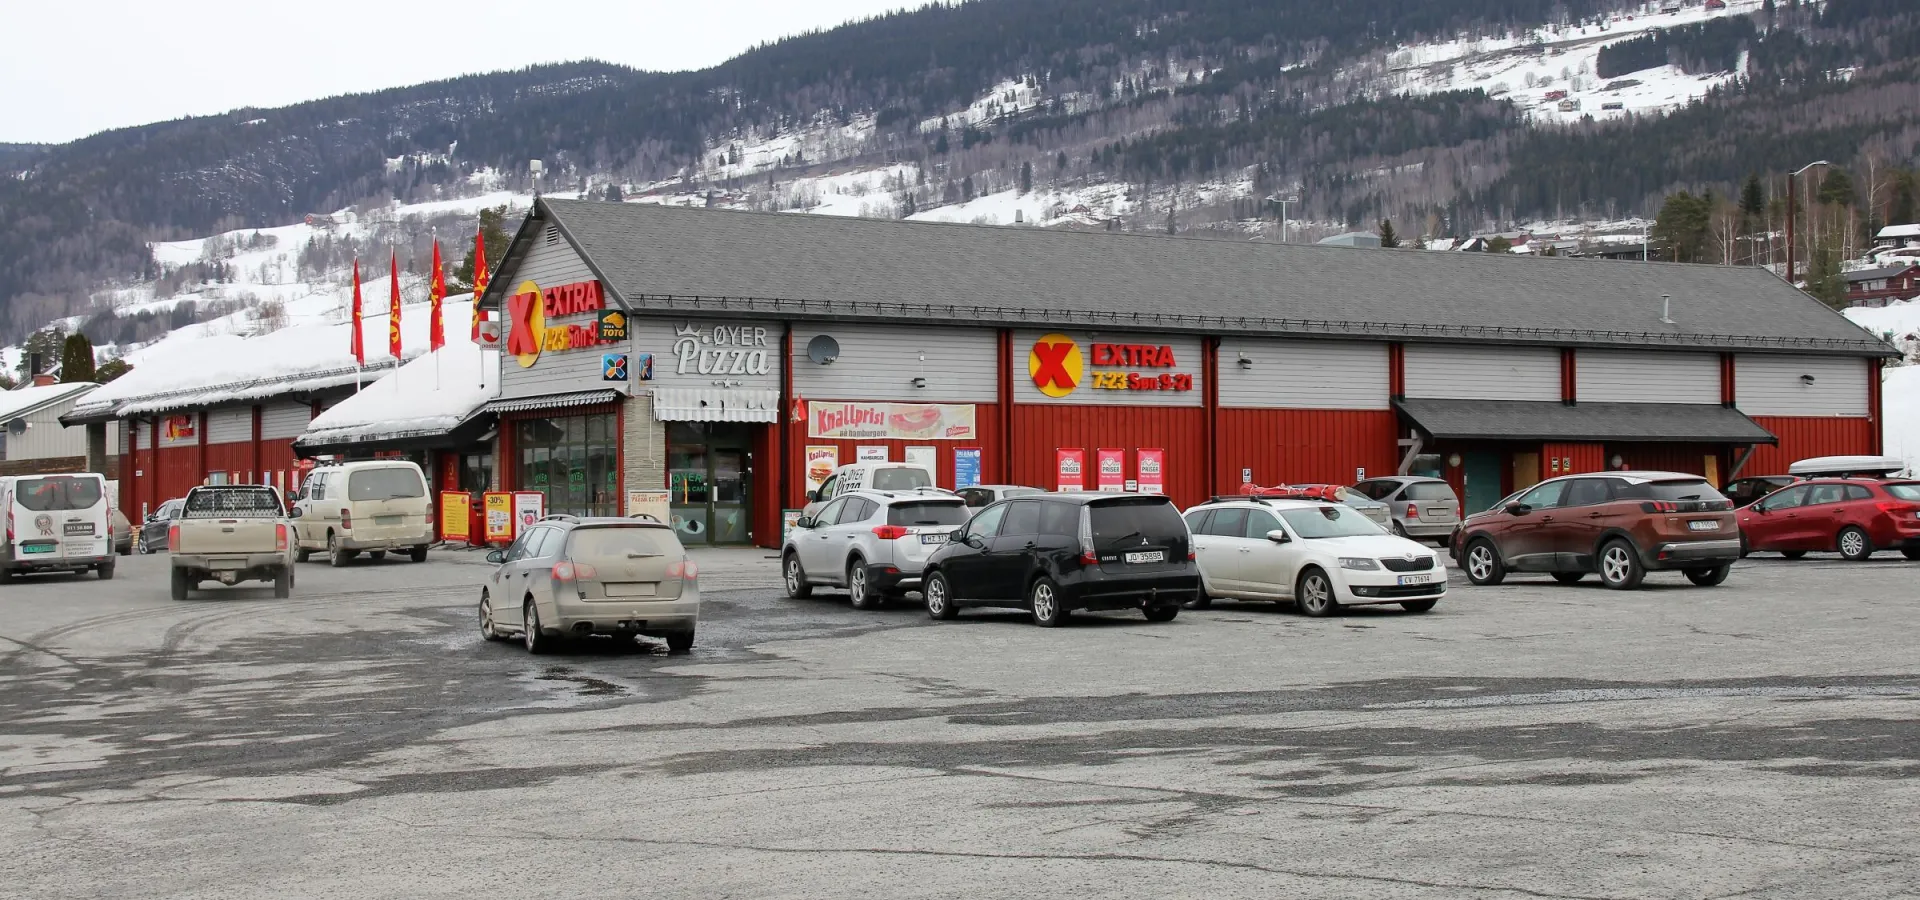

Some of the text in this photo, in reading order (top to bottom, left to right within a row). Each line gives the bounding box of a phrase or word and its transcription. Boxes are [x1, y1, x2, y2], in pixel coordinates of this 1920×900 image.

[543, 280, 602, 317] EXTRA
[568, 325, 588, 349] Søn
[604, 329, 624, 337] TOTO
[713, 325, 767, 346] ØYER
[673, 337, 771, 375] Pizza
[1091, 344, 1176, 367] EXTRA
[1092, 372, 1193, 391] 7-23 Søn 9-21
[818, 405, 885, 436] Knallpris!
[849, 429, 887, 437] hamburgere
[673, 472, 703, 483] ØYER
[488, 496, 504, 504] -30%
